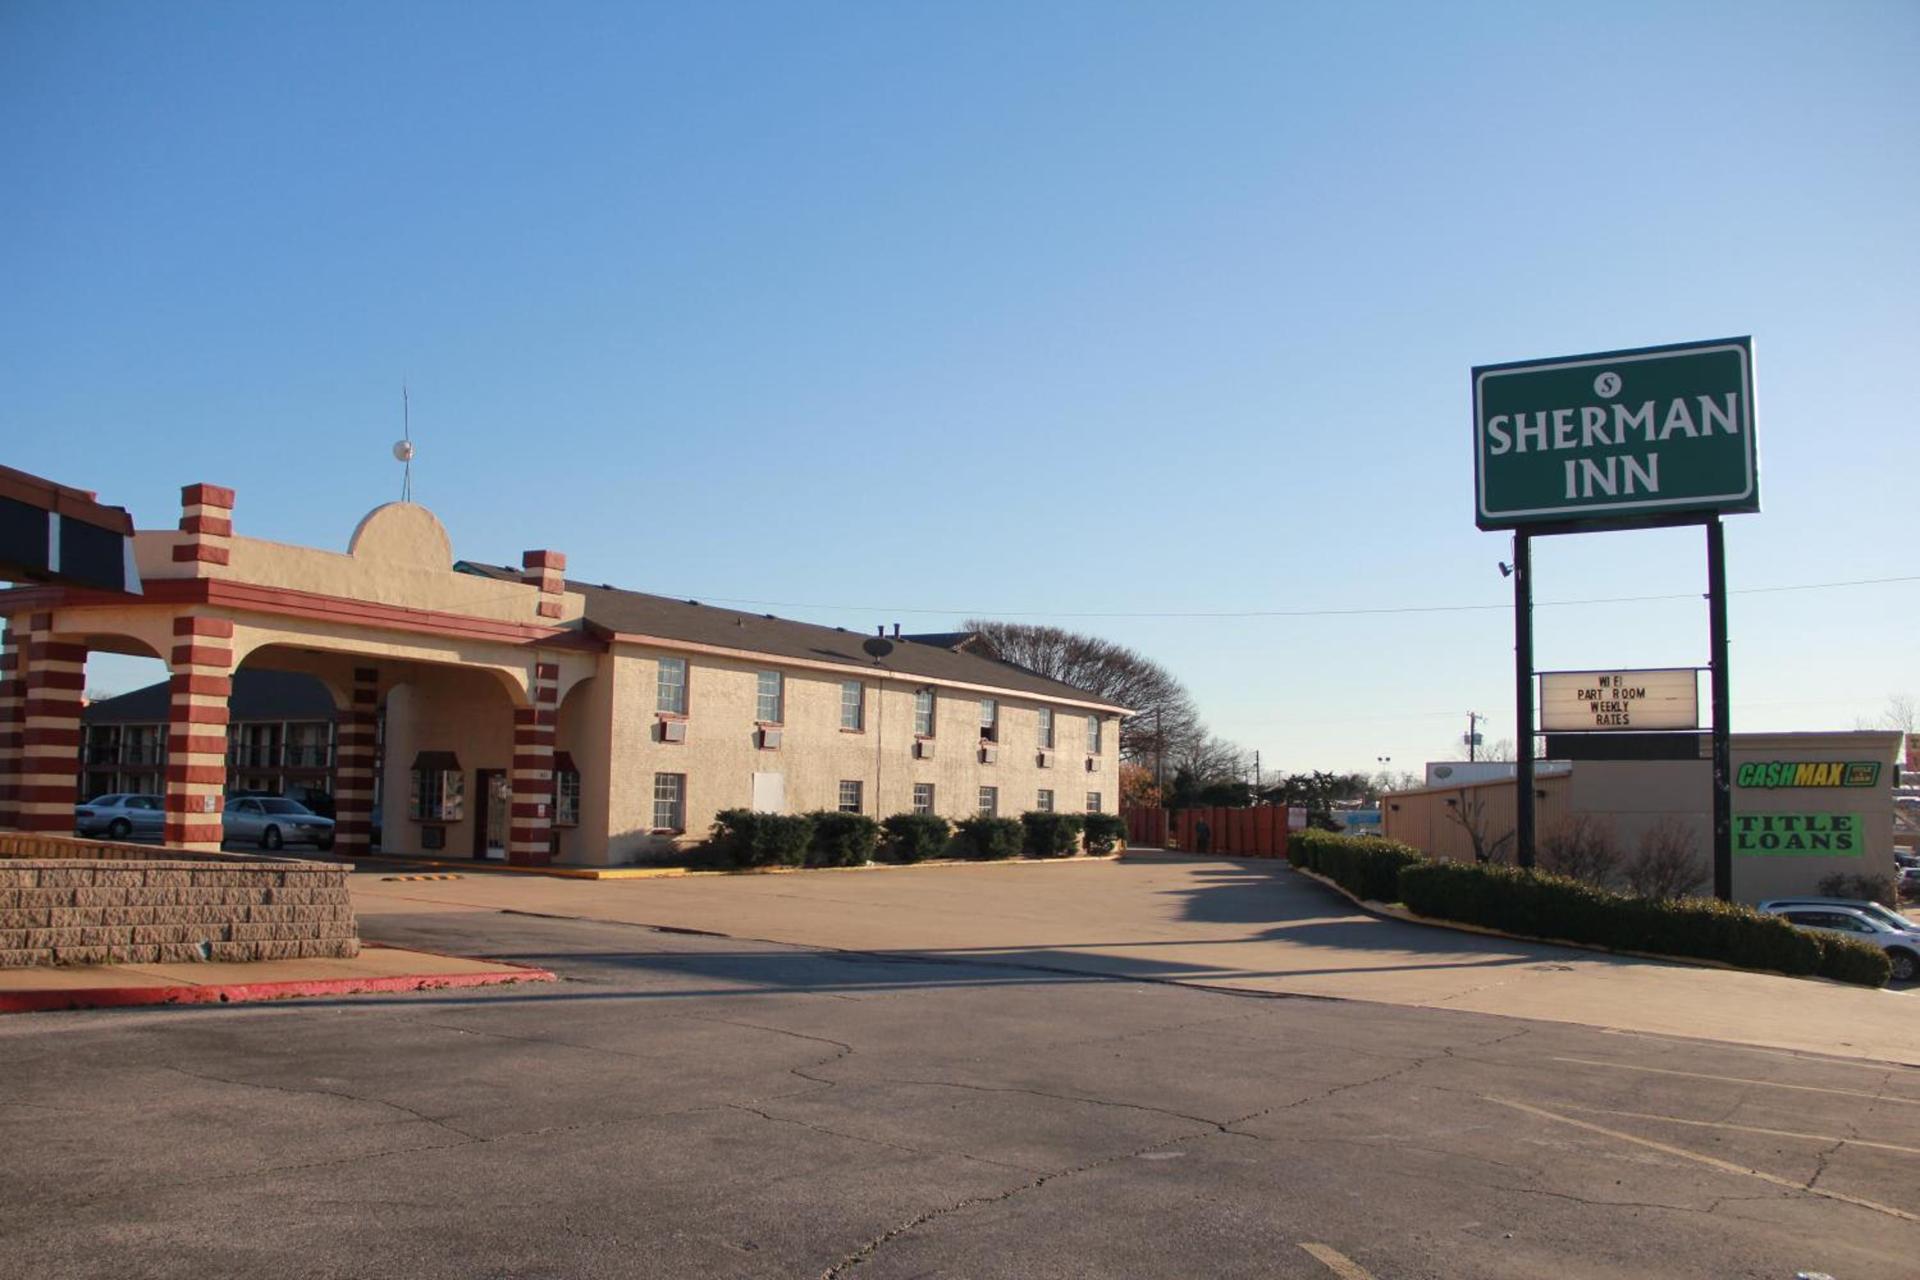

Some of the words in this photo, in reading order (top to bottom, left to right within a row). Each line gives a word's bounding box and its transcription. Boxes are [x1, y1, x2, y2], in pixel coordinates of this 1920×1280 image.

[1487, 392, 1739, 456] SHERMAN
[1564, 453, 1659, 498] INN
[1613, 687, 1645, 699] ROOM
[1591, 701, 1629, 712] WEEKLY
[1596, 713, 1629, 725] RATES
[1737, 815, 1852, 832] TITLE
[1738, 832, 1853, 849] LOANS
